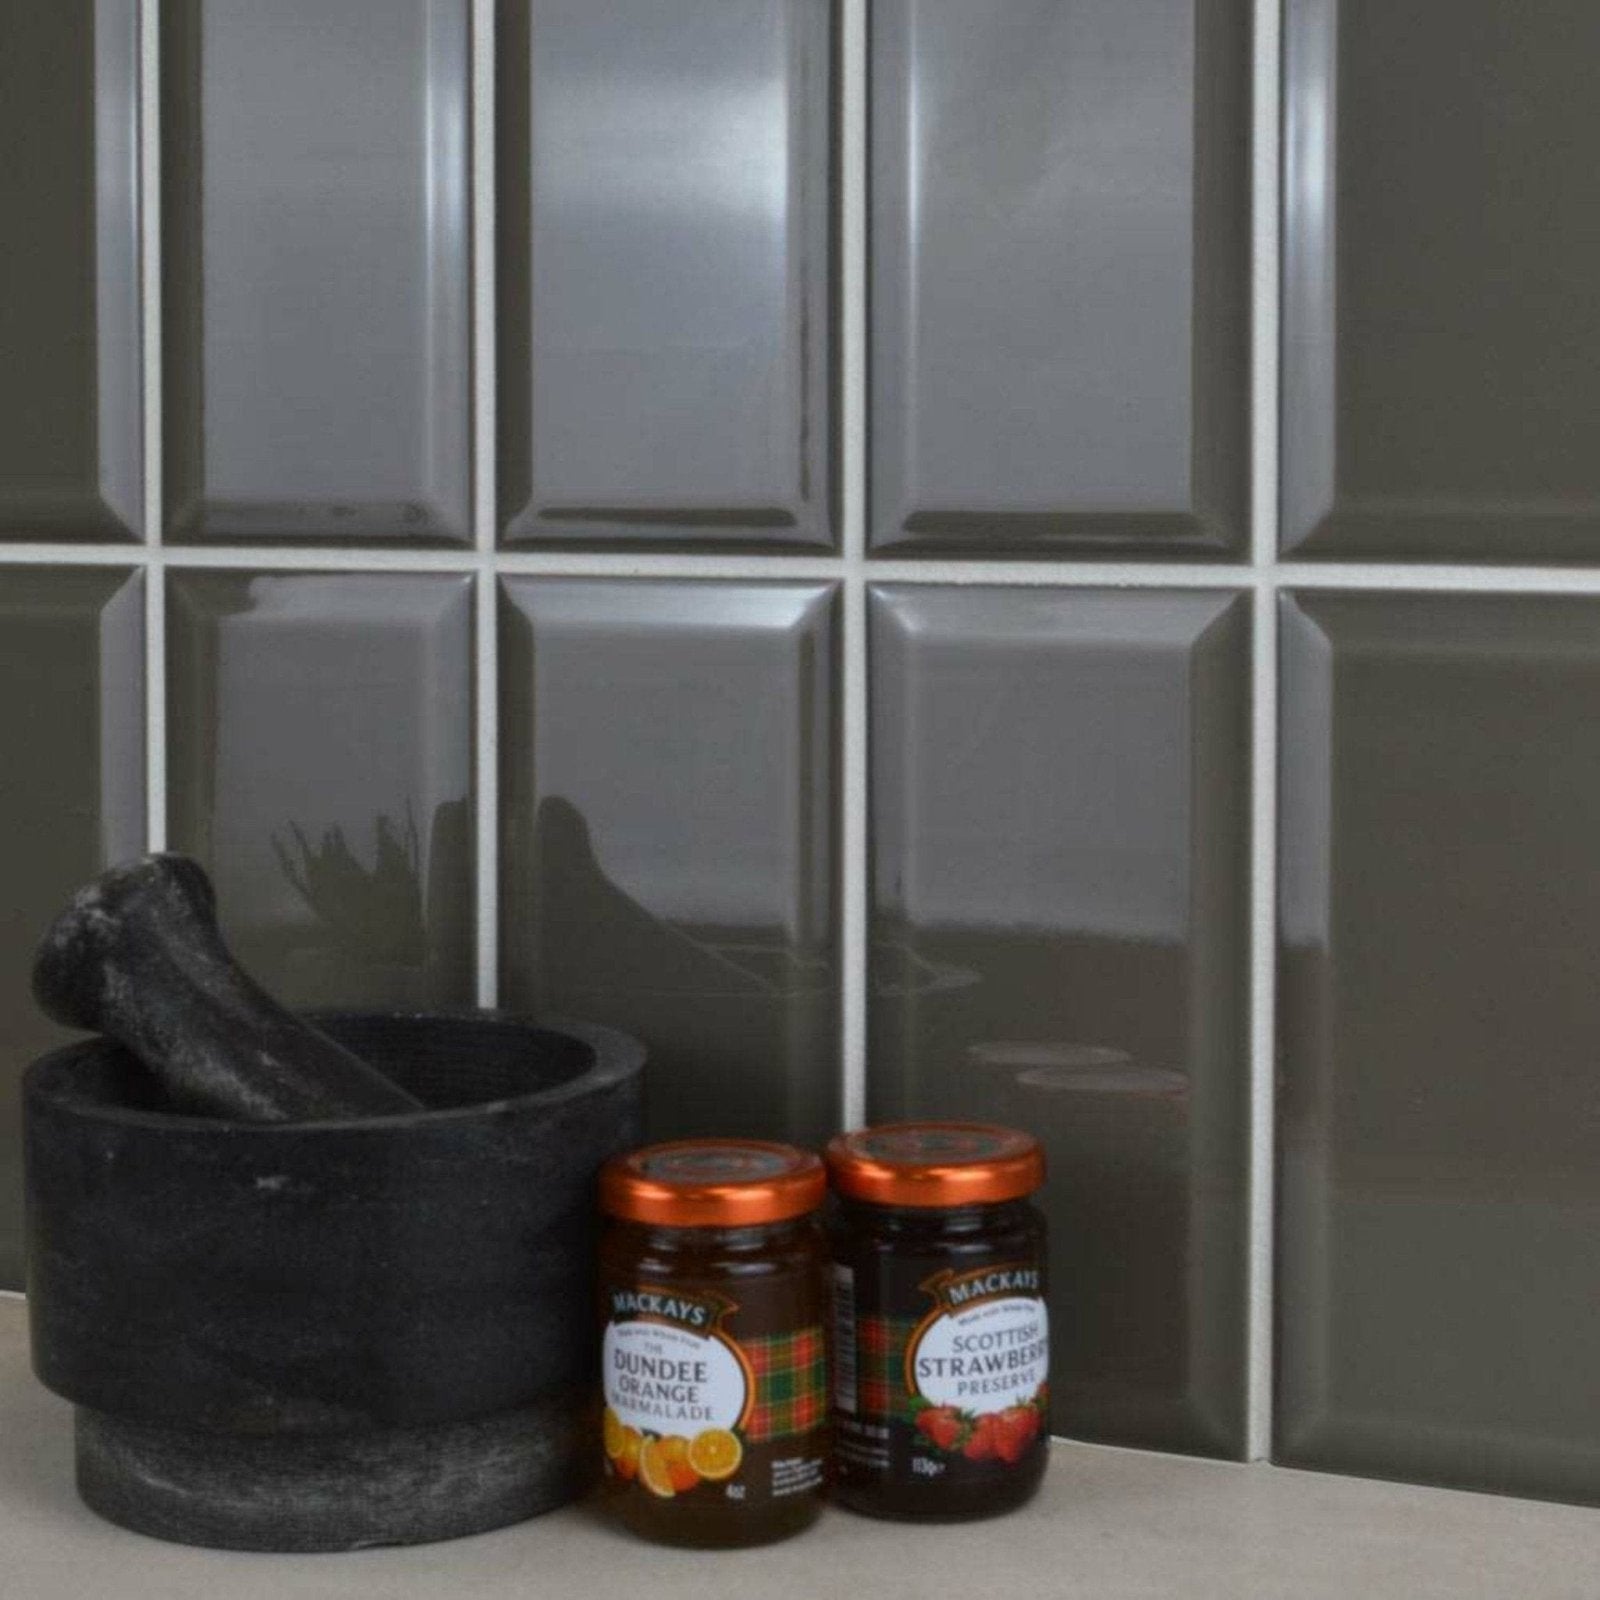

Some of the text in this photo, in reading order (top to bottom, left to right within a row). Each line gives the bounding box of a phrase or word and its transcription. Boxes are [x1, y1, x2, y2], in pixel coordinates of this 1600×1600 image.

[613, 1292, 706, 1325] MACKAYS
[952, 1321, 1039, 1353] SCOTTISH
[613, 1348, 708, 1383] DUNDEE
[957, 1367, 1036, 1396] PRESERVE
[611, 1389, 714, 1421] MARMALADE
[618, 1374, 700, 1404] ORANGE
